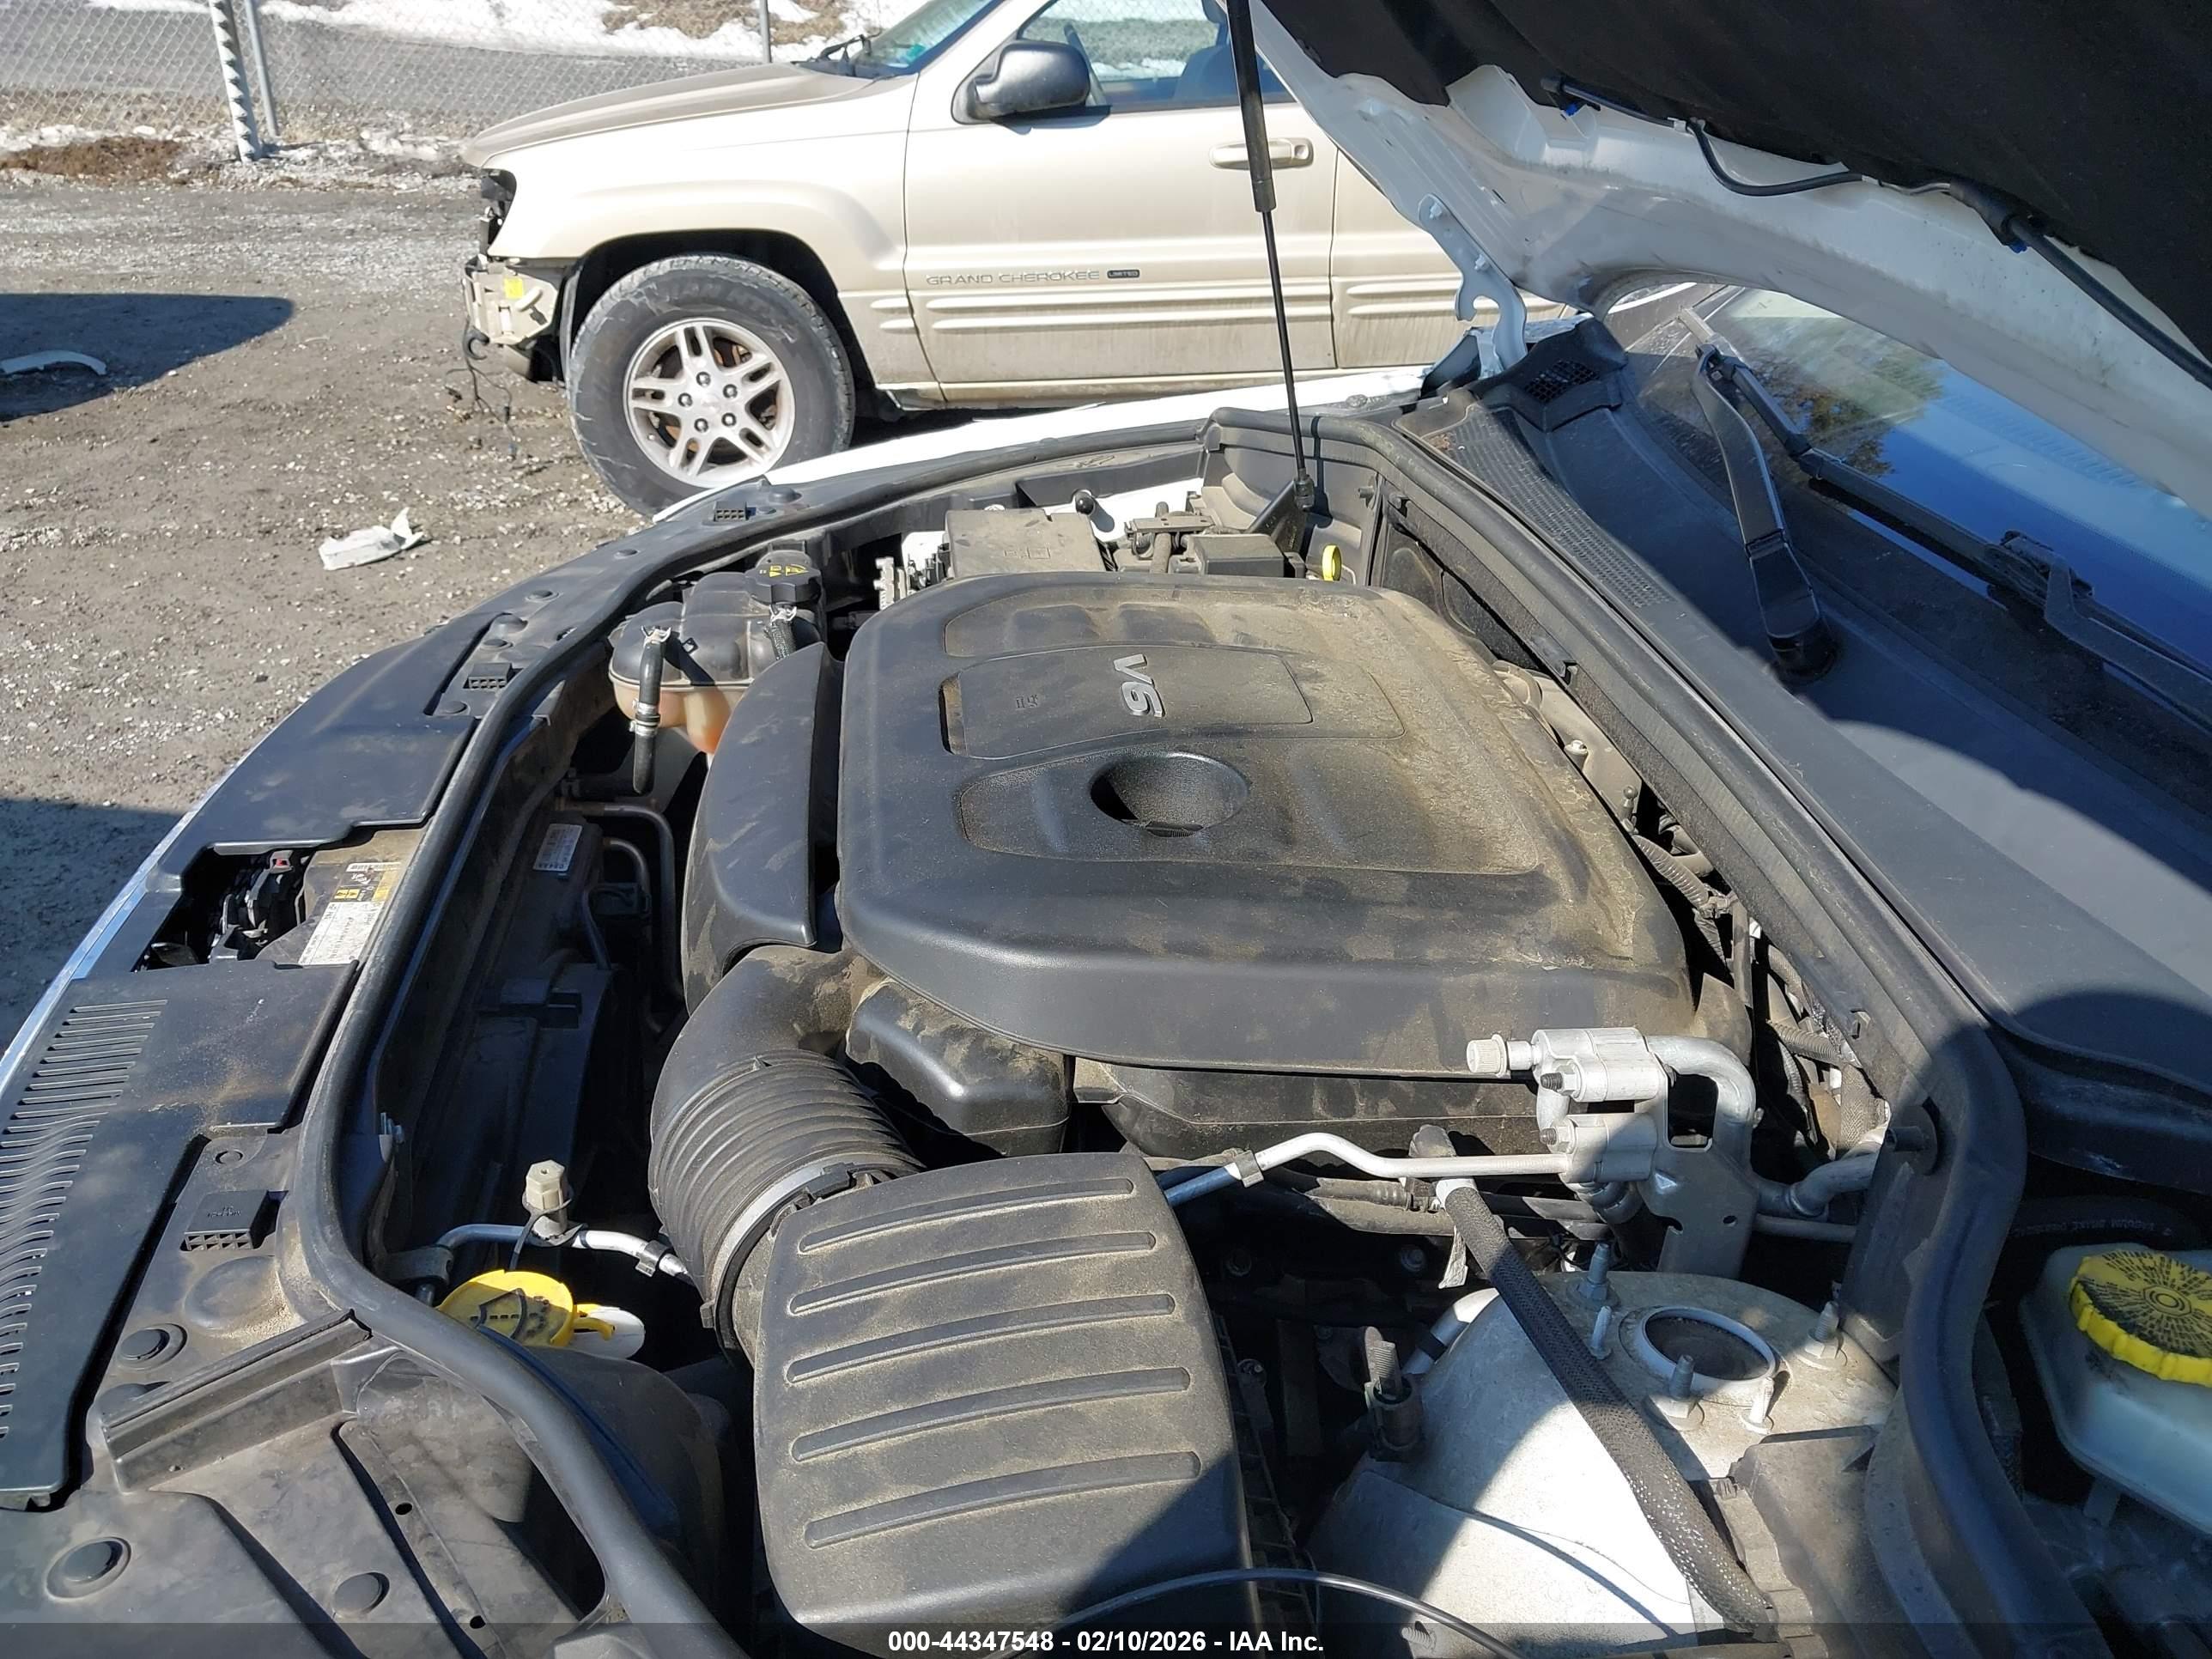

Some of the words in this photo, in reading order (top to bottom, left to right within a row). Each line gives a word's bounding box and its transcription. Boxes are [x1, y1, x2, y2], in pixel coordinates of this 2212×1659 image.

[926, 275, 993, 285] GRAND
[999, 270, 1100, 283] CHEROKEE
[1114, 653, 1164, 717] V6
